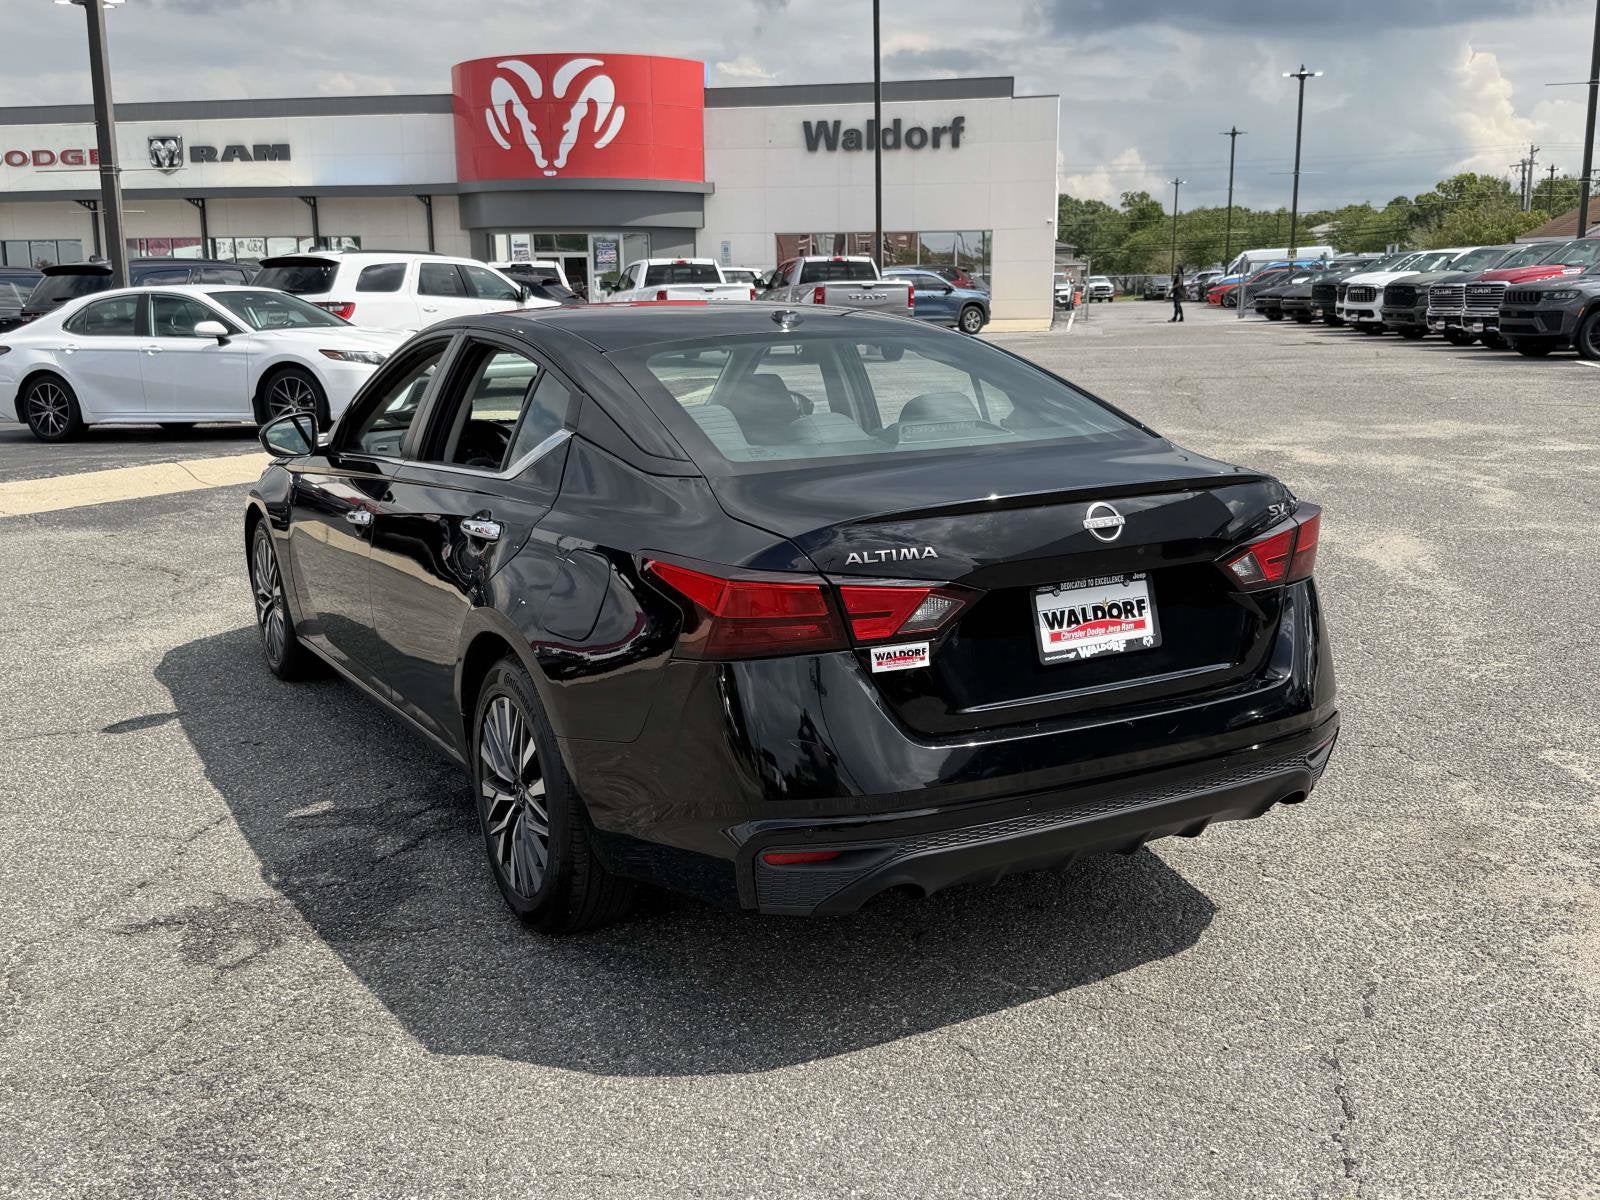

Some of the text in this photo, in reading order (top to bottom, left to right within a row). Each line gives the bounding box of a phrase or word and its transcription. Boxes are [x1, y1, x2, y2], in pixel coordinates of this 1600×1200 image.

[802, 116, 966, 152] Waldorf
[189, 143, 291, 163] RAM
[1085, 516, 1125, 529] NISSAN
[844, 546, 939, 566] ALTIMA
[1060, 580, 1087, 591] DEDICATED
[1087, 578, 1095, 587] TO
[1094, 574, 1124, 586] EXCELLENCE
[1132, 572, 1147, 580] Jeep
[1042, 599, 1146, 630] WALDORF
[1060, 622, 1135, 640] Chrysler Dodge Jeep Ram
[874, 647, 927, 662] WALDORF
[1077, 640, 1126, 658] WALDORF
